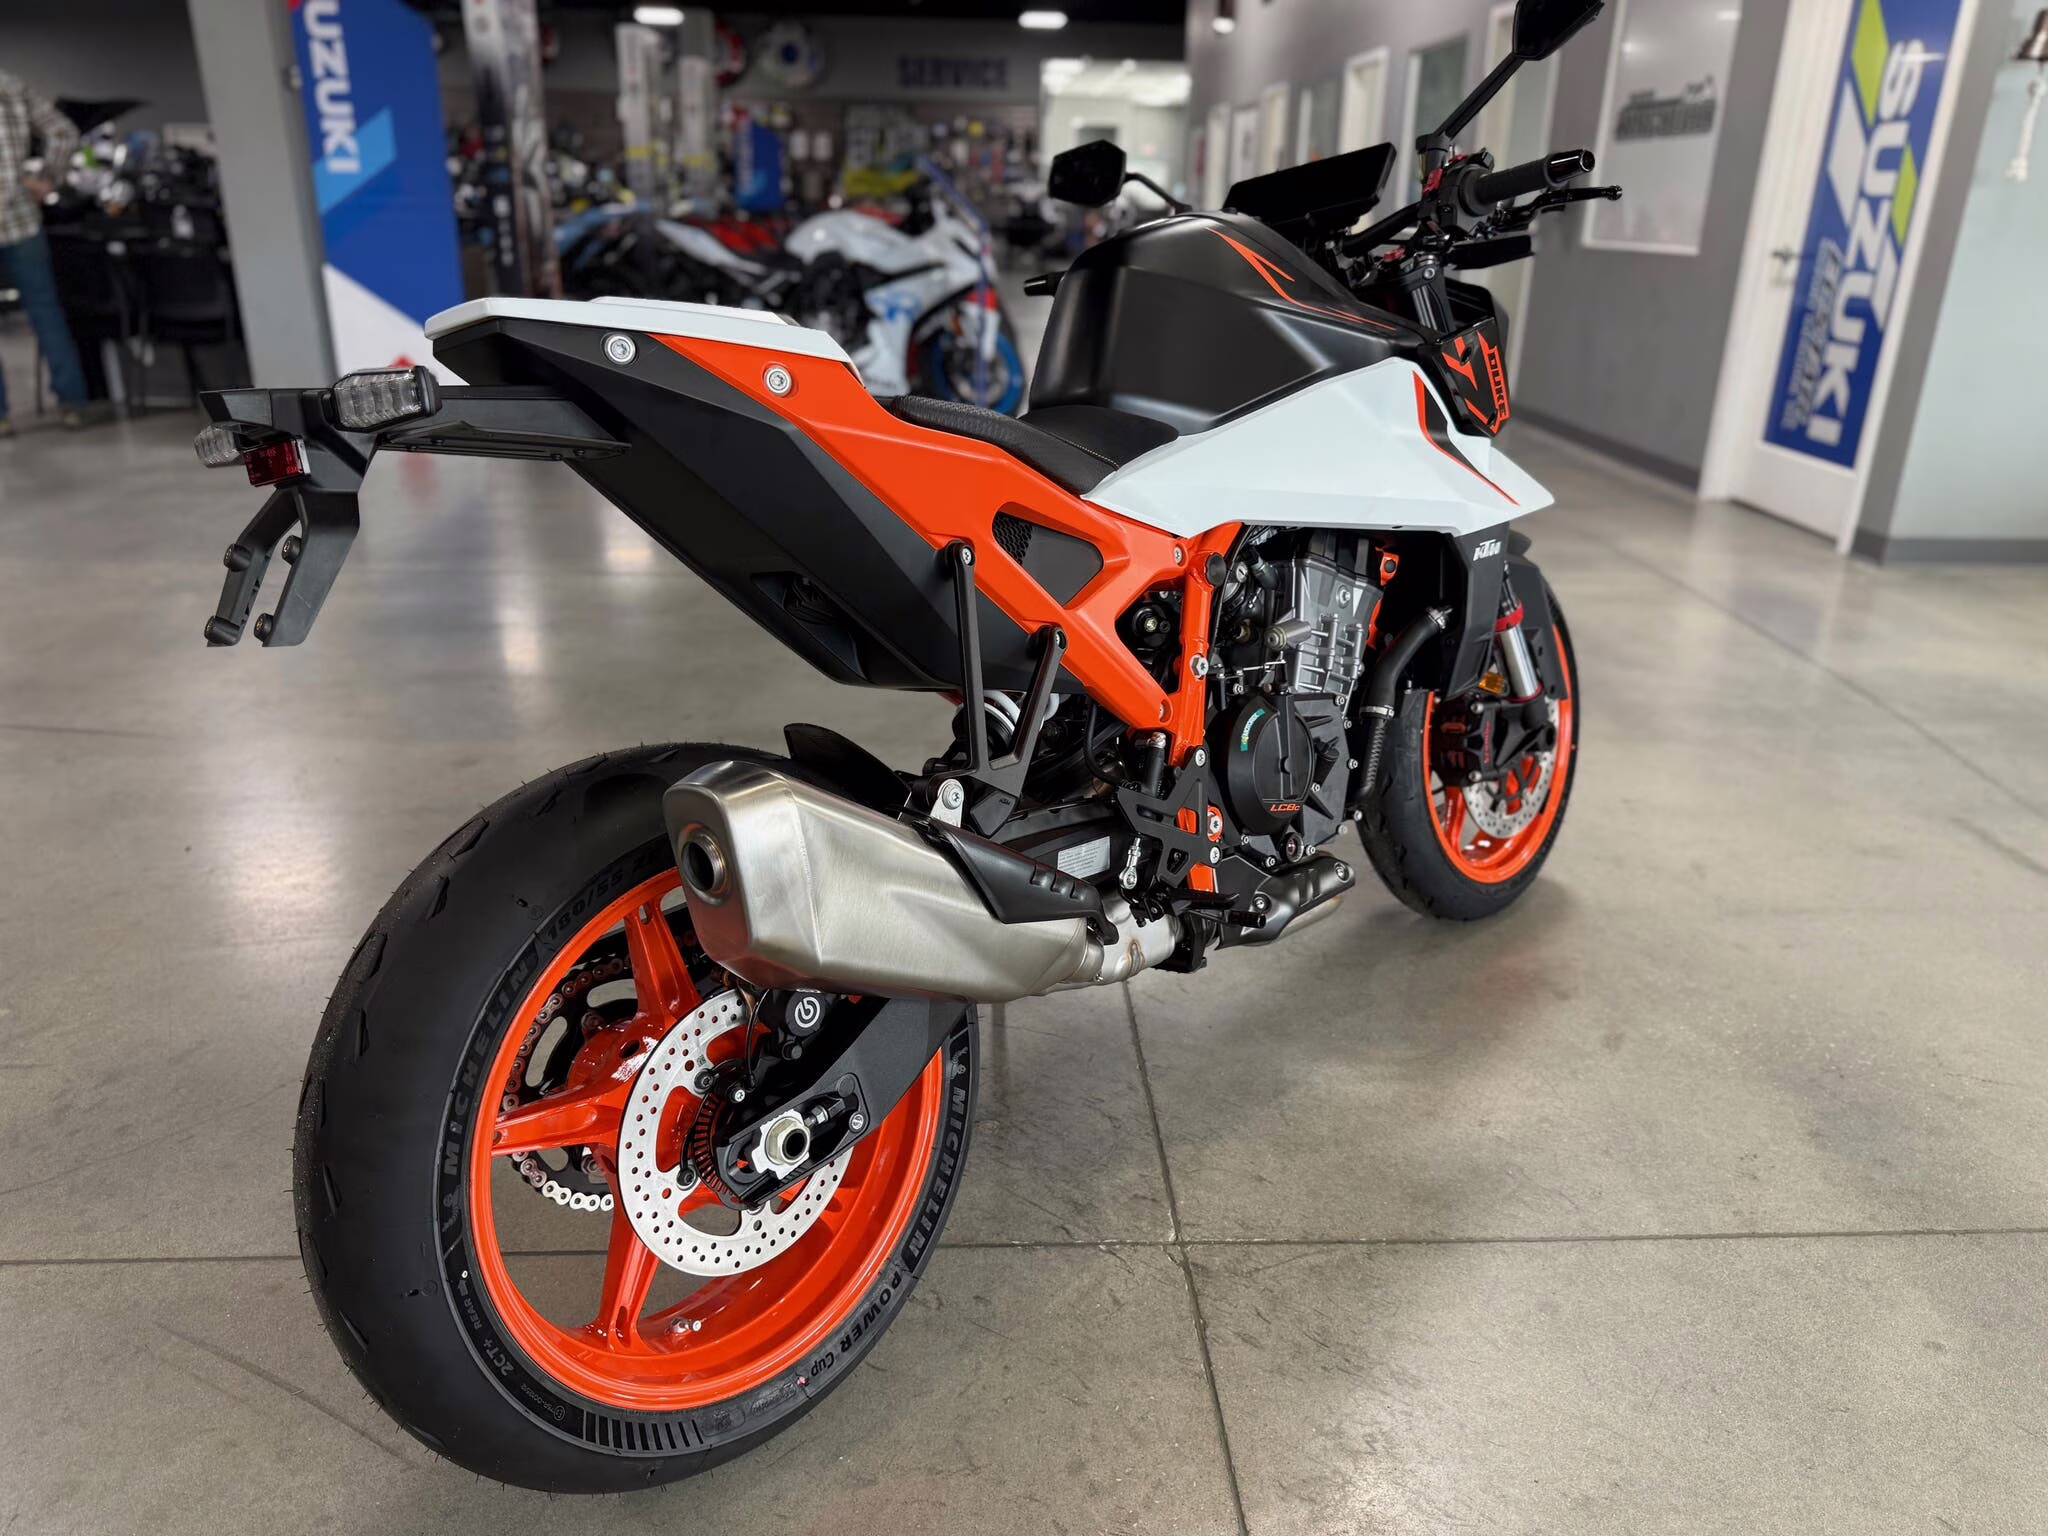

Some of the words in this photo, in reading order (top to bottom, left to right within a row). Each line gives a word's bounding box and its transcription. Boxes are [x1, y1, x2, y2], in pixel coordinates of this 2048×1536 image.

[1806, 39, 1926, 447] SUZUKI
[1488, 352, 1508, 418] DUKE
[1473, 539, 1502, 561] KTM
[443, 964, 529, 1176] MICHELIN
[908, 1086, 967, 1258] MICHELIN
[463, 1297, 483, 1331] REAR
[839, 1270, 903, 1354] POWER
[483, 1338, 515, 1377] 2CT+
